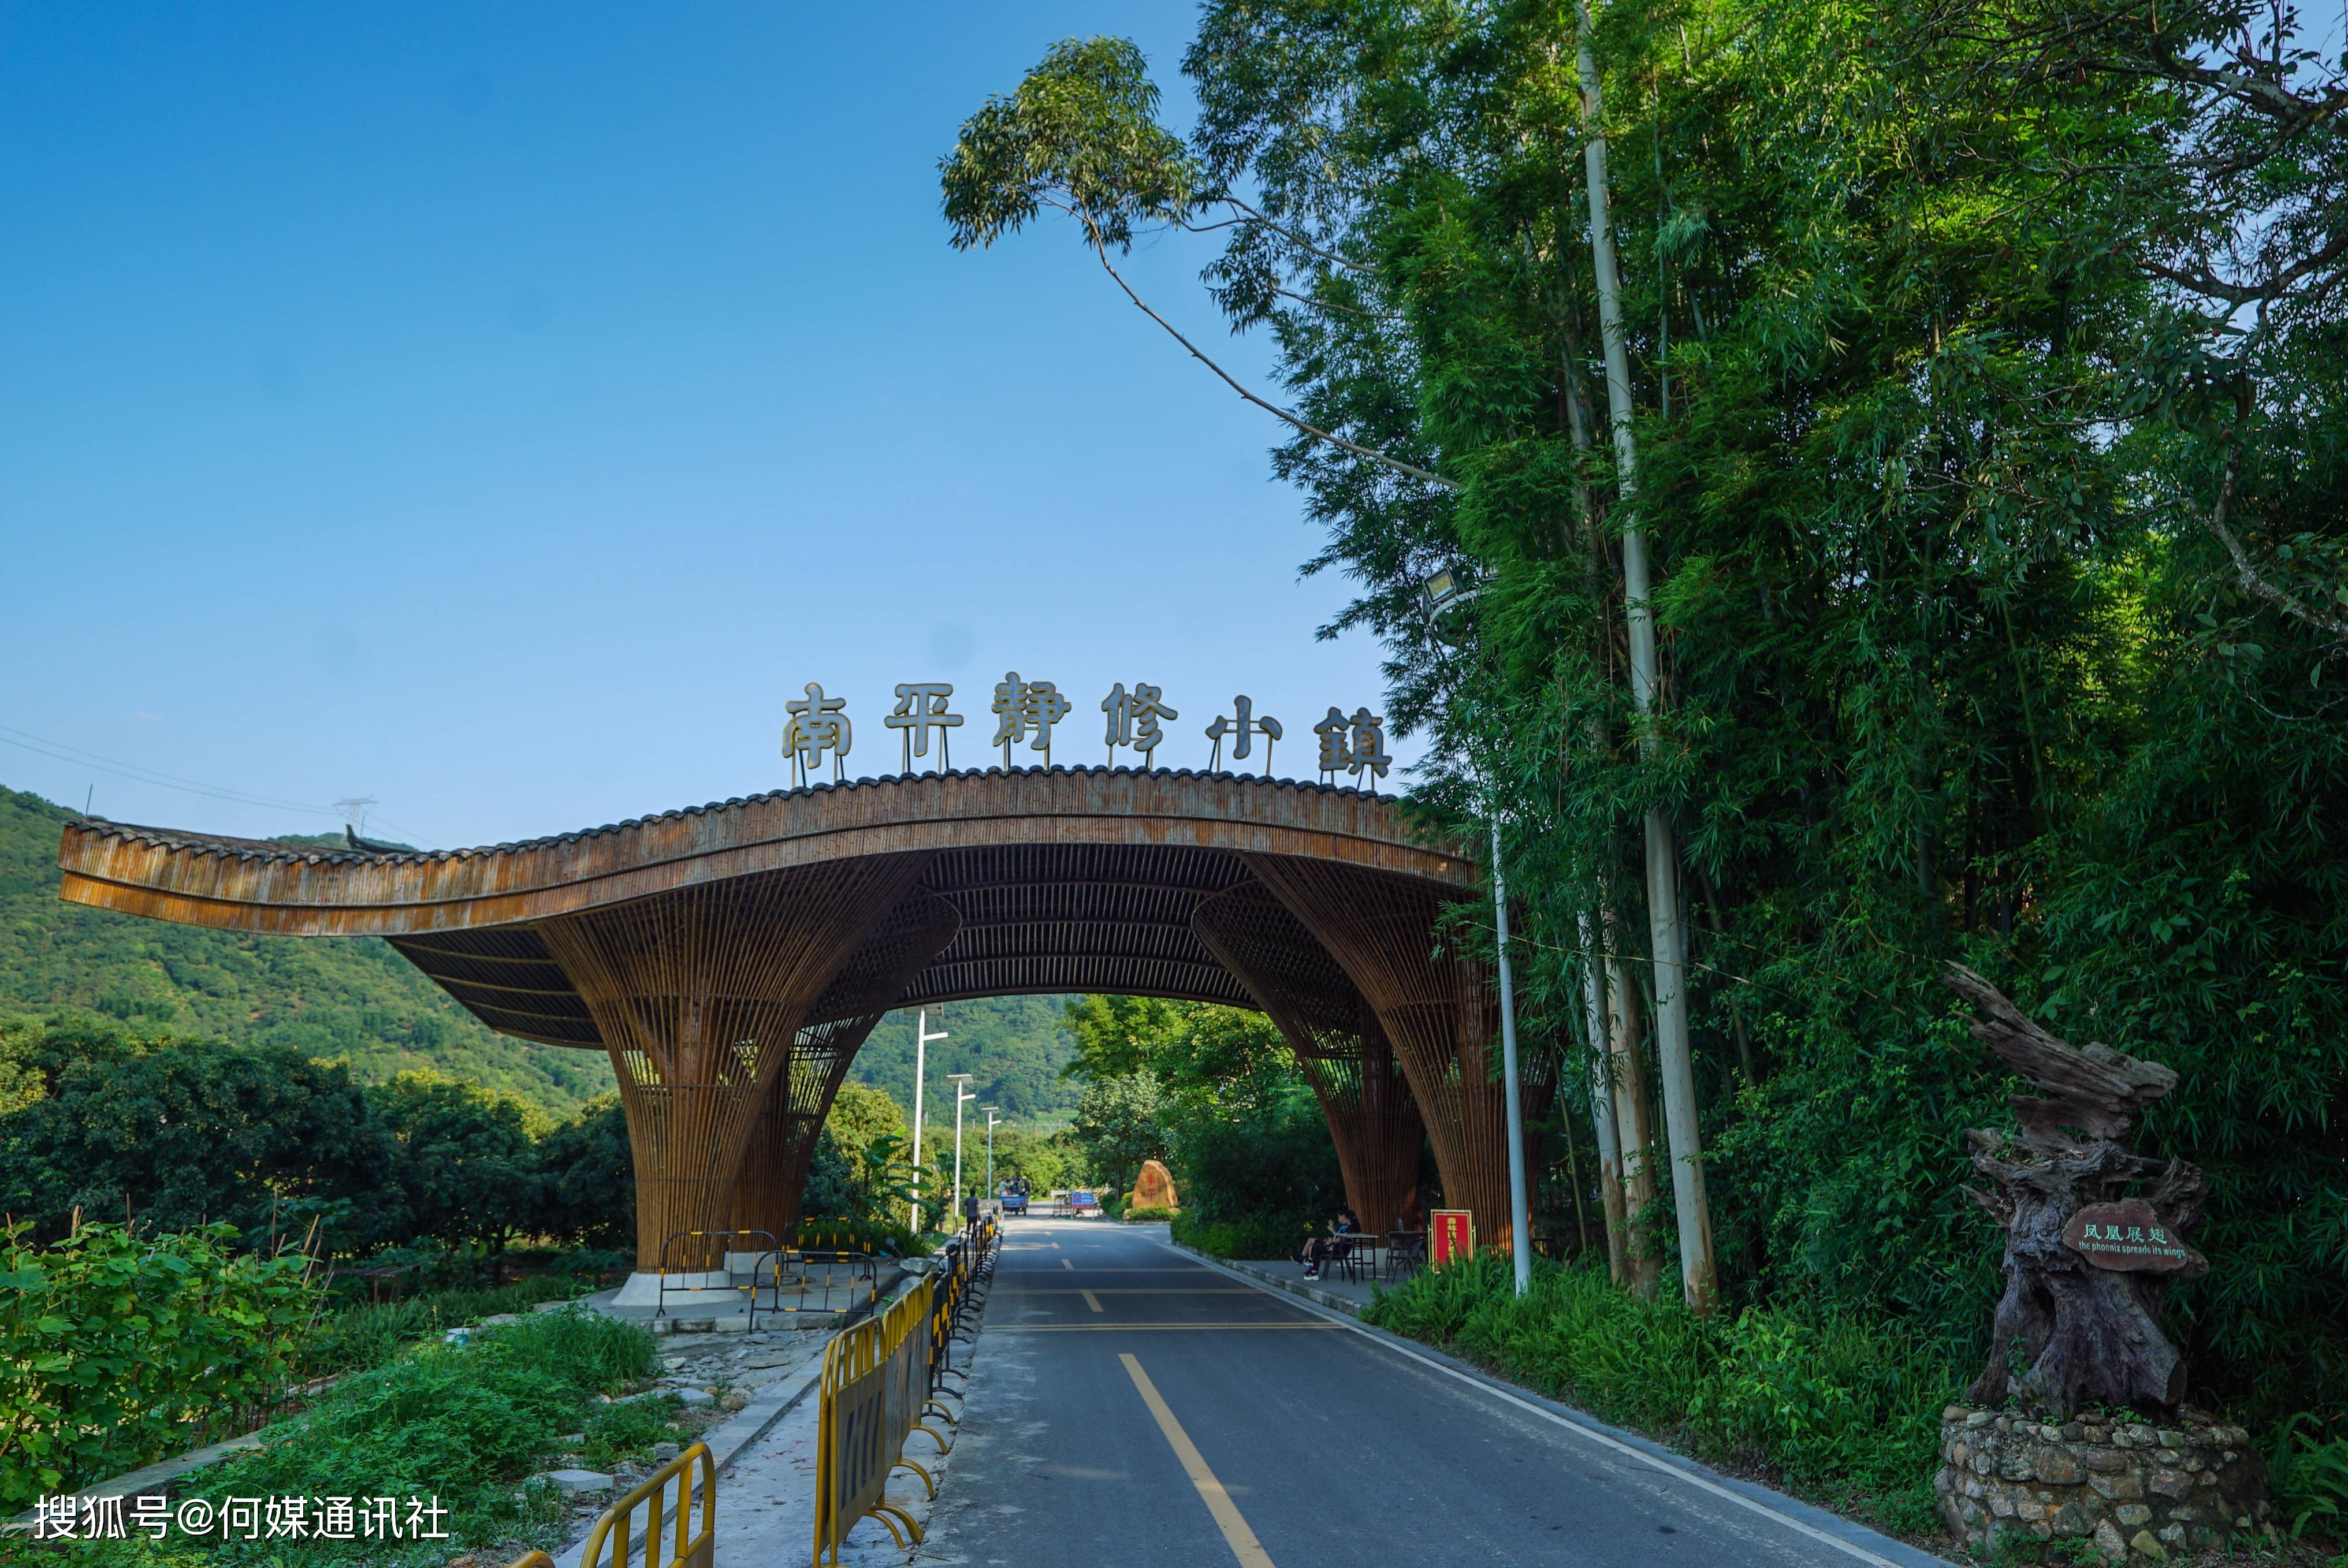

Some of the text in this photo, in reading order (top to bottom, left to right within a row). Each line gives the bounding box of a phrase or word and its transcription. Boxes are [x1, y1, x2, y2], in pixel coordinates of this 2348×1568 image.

[1146, 1173, 1156, 1200] 南平
[2083, 1224, 2168, 1245] 凤凰展翅
[2079, 1241, 2090, 1250] the
[2122, 1245, 2151, 1255] spreads
[2152, 1245, 2162, 1256] its
[2163, 1246, 2186, 1259] wings
